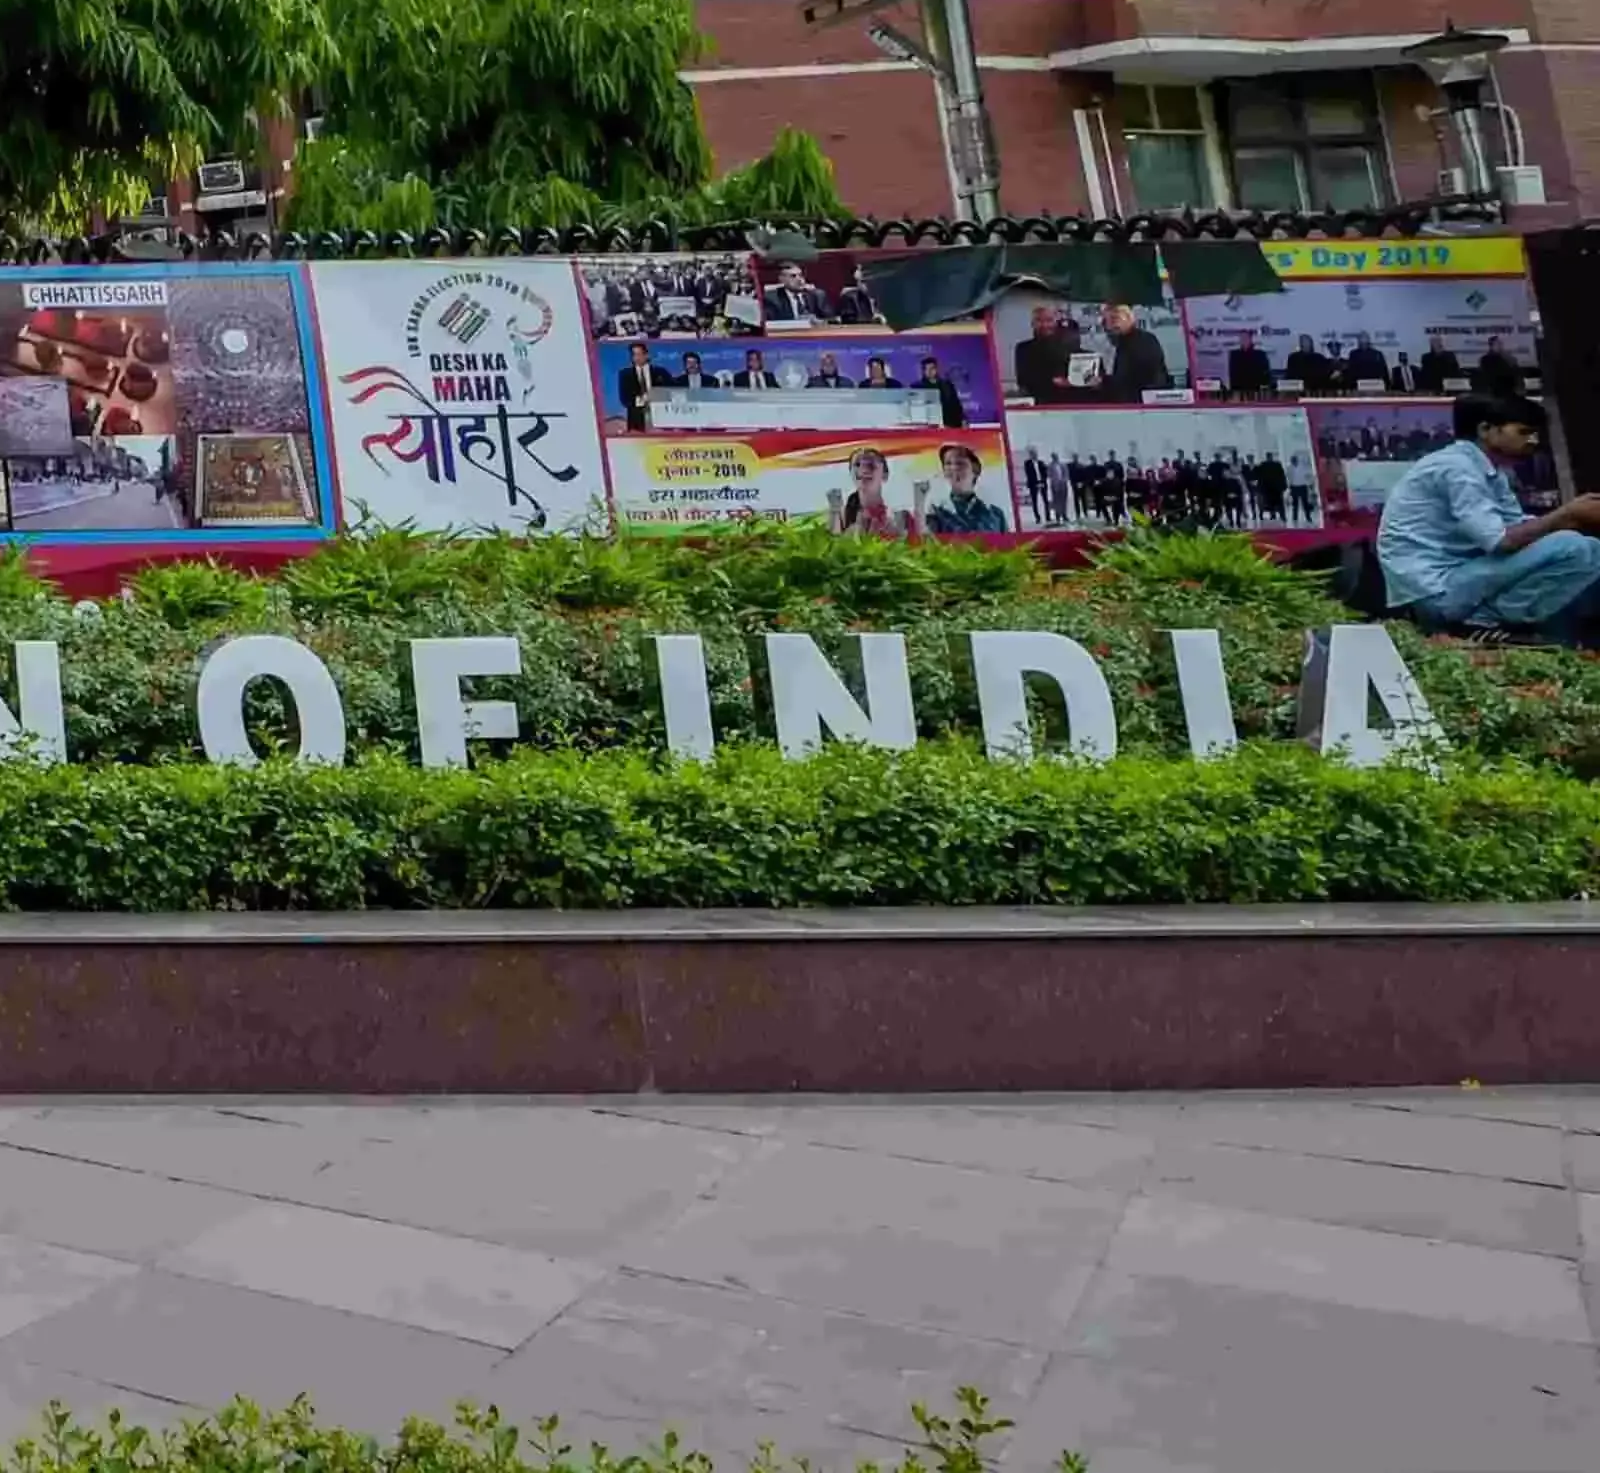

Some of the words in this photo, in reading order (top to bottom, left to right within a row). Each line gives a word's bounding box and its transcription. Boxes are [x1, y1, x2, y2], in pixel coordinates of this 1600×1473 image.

[1311, 247, 1368, 271] Day
[1377, 245, 1450, 267] 2019
[29, 284, 164, 305] CHHATTISGARH
[430, 353, 478, 372] DESH
[482, 352, 509, 371] KA
[432, 376, 512, 402] MAHA
[712, 463, 745, 477] 2019
[200, 634, 523, 770] OF
[655, 624, 1450, 783] INDIA
